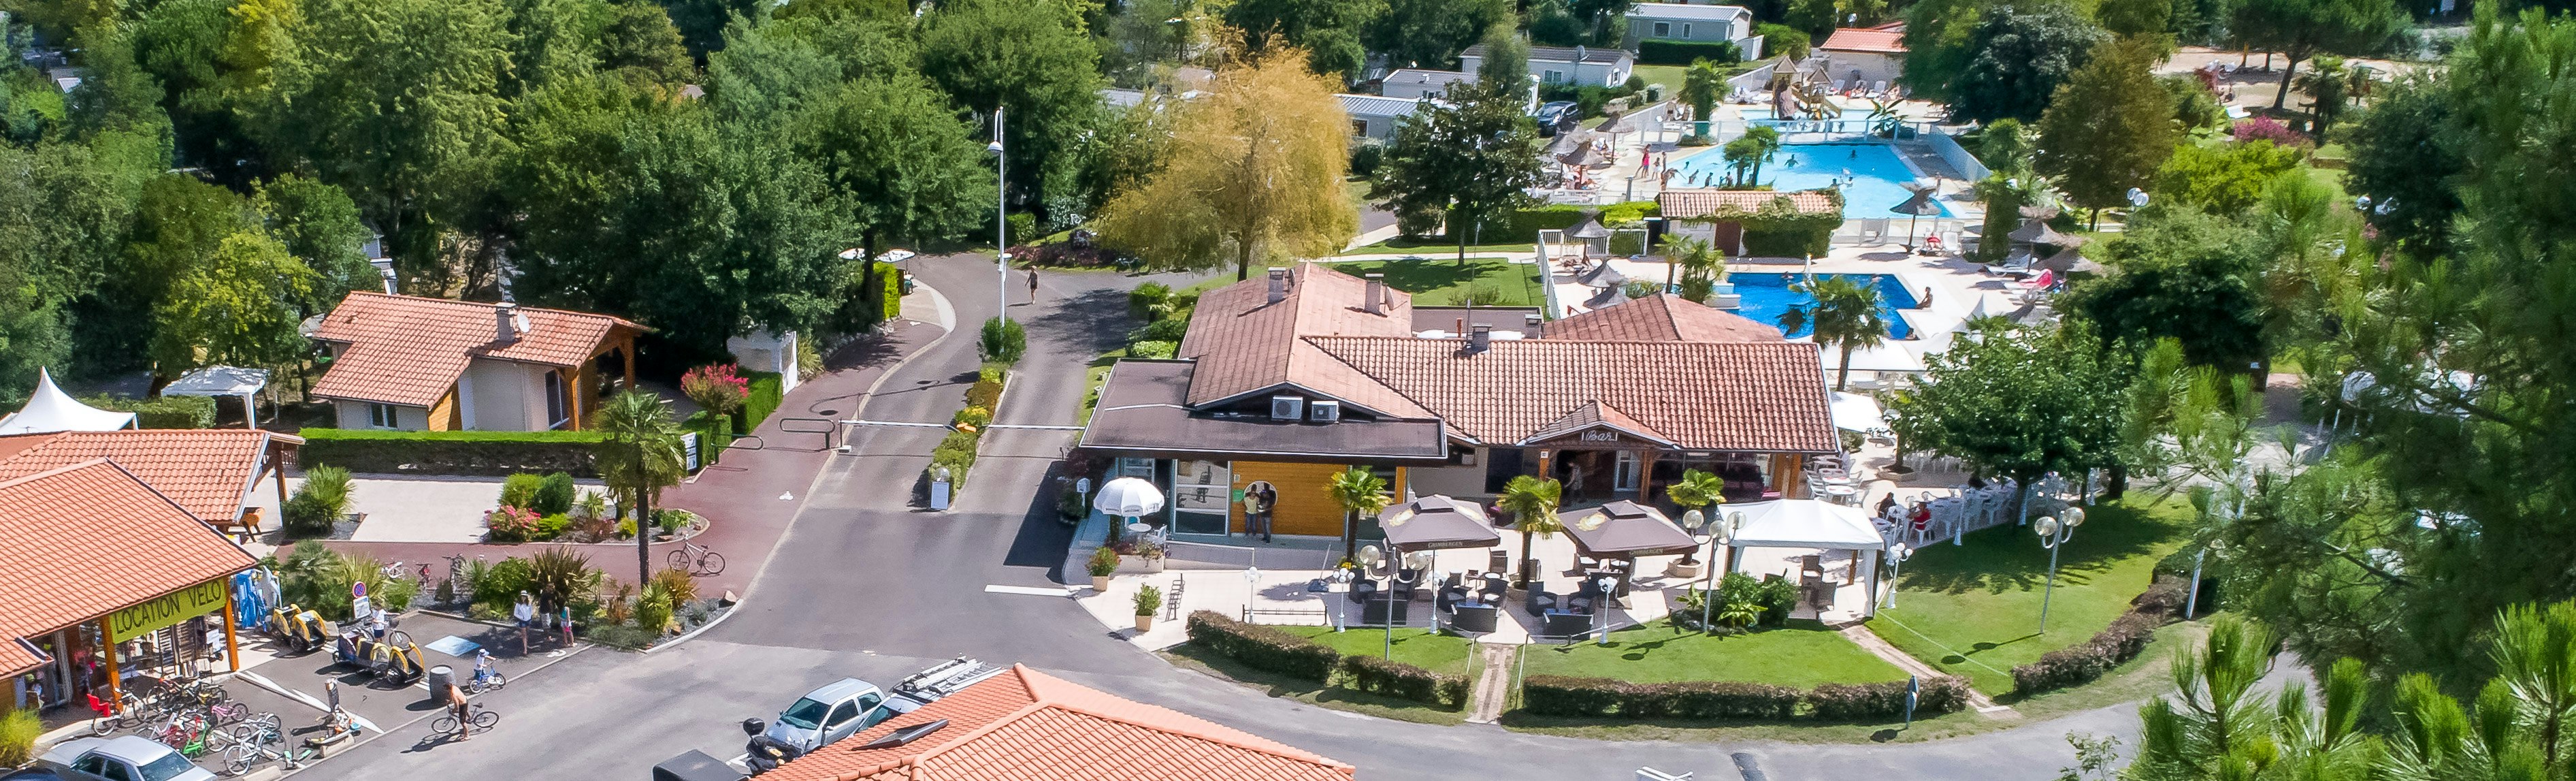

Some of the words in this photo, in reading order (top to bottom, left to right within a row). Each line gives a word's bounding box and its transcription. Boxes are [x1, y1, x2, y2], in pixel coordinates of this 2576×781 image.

[1585, 430, 1615, 441] Bar
[114, 594, 180, 634] LOCATION
[187, 580, 221, 608] VELO
